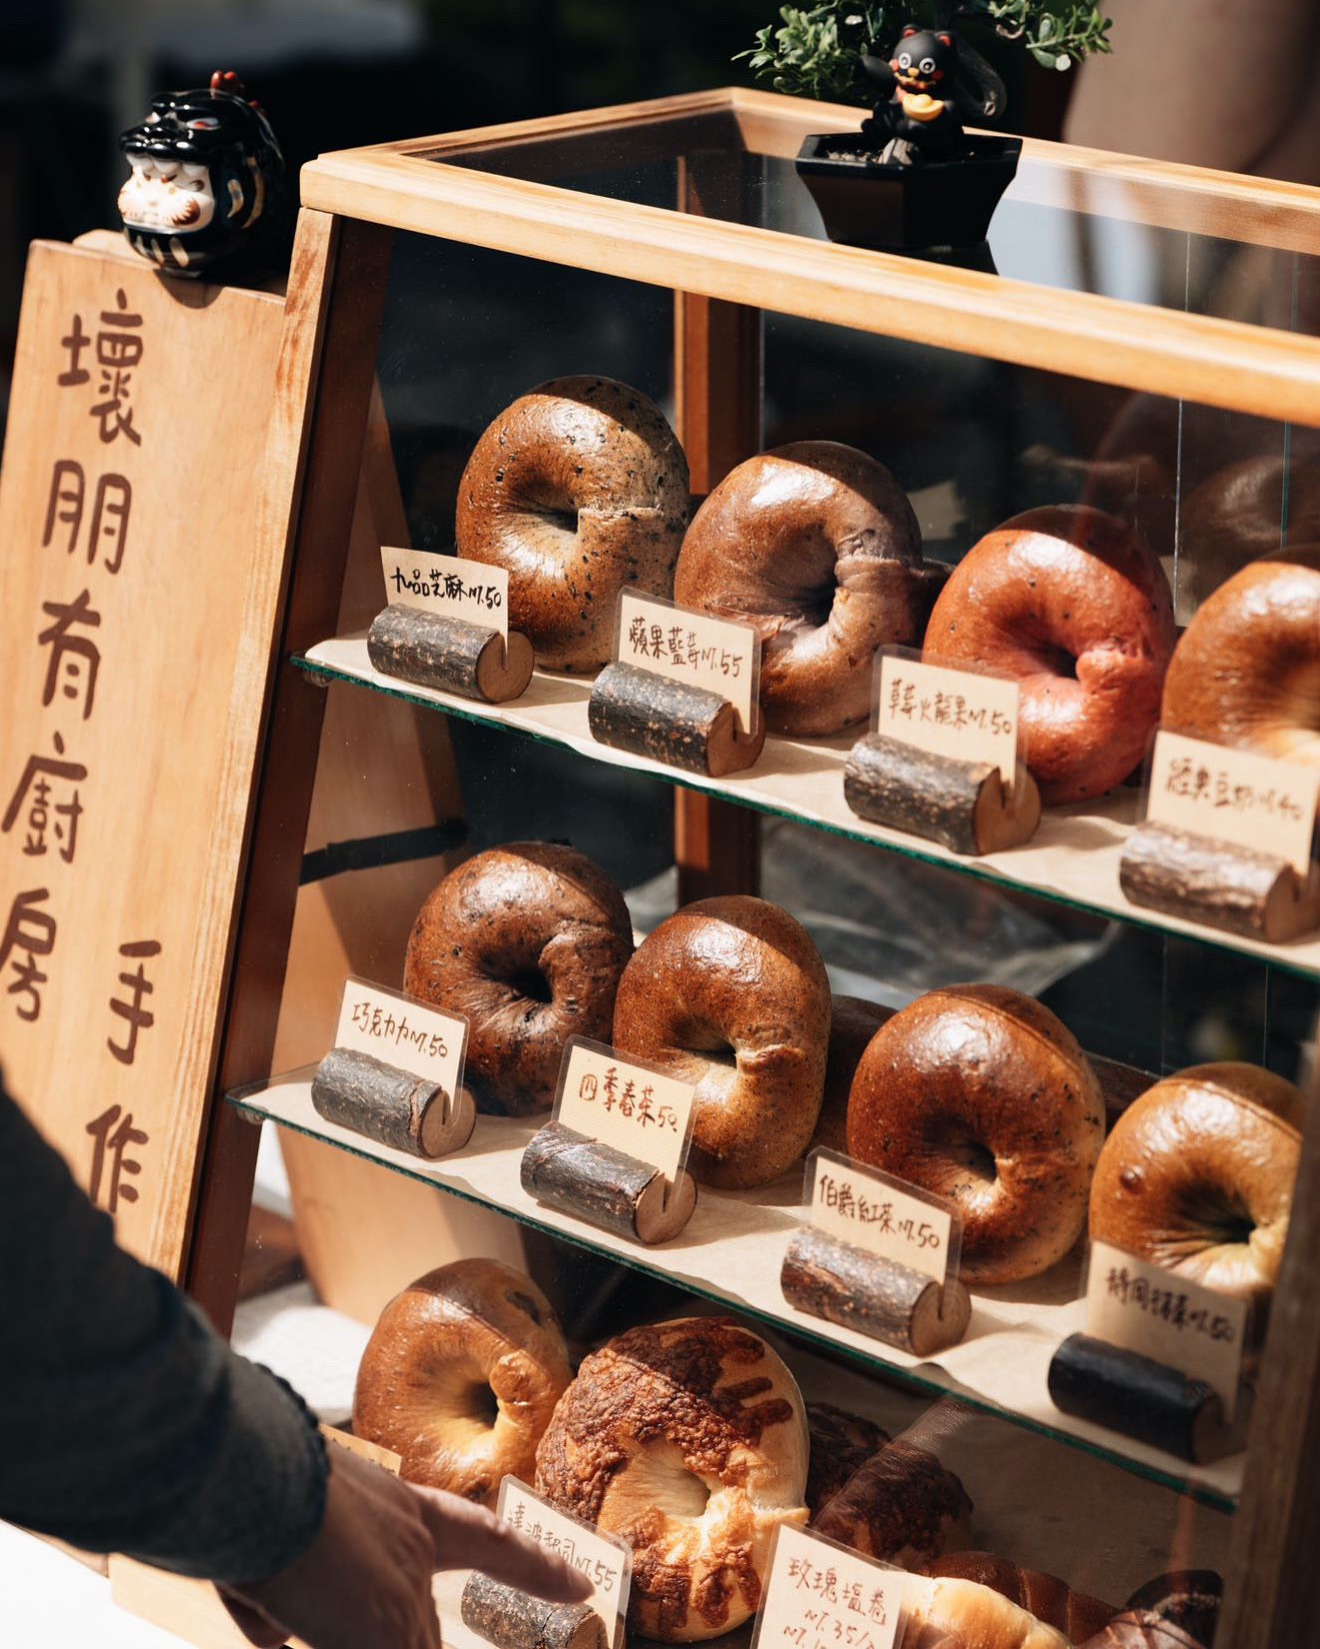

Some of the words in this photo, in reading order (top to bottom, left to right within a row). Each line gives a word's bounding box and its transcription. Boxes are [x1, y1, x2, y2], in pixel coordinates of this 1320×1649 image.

[0, 287, 144, 1023] 壞朋有廚房
[86, 940, 163, 1214] 手作
[819, 1173, 896, 1234] 伯爵紅茶
